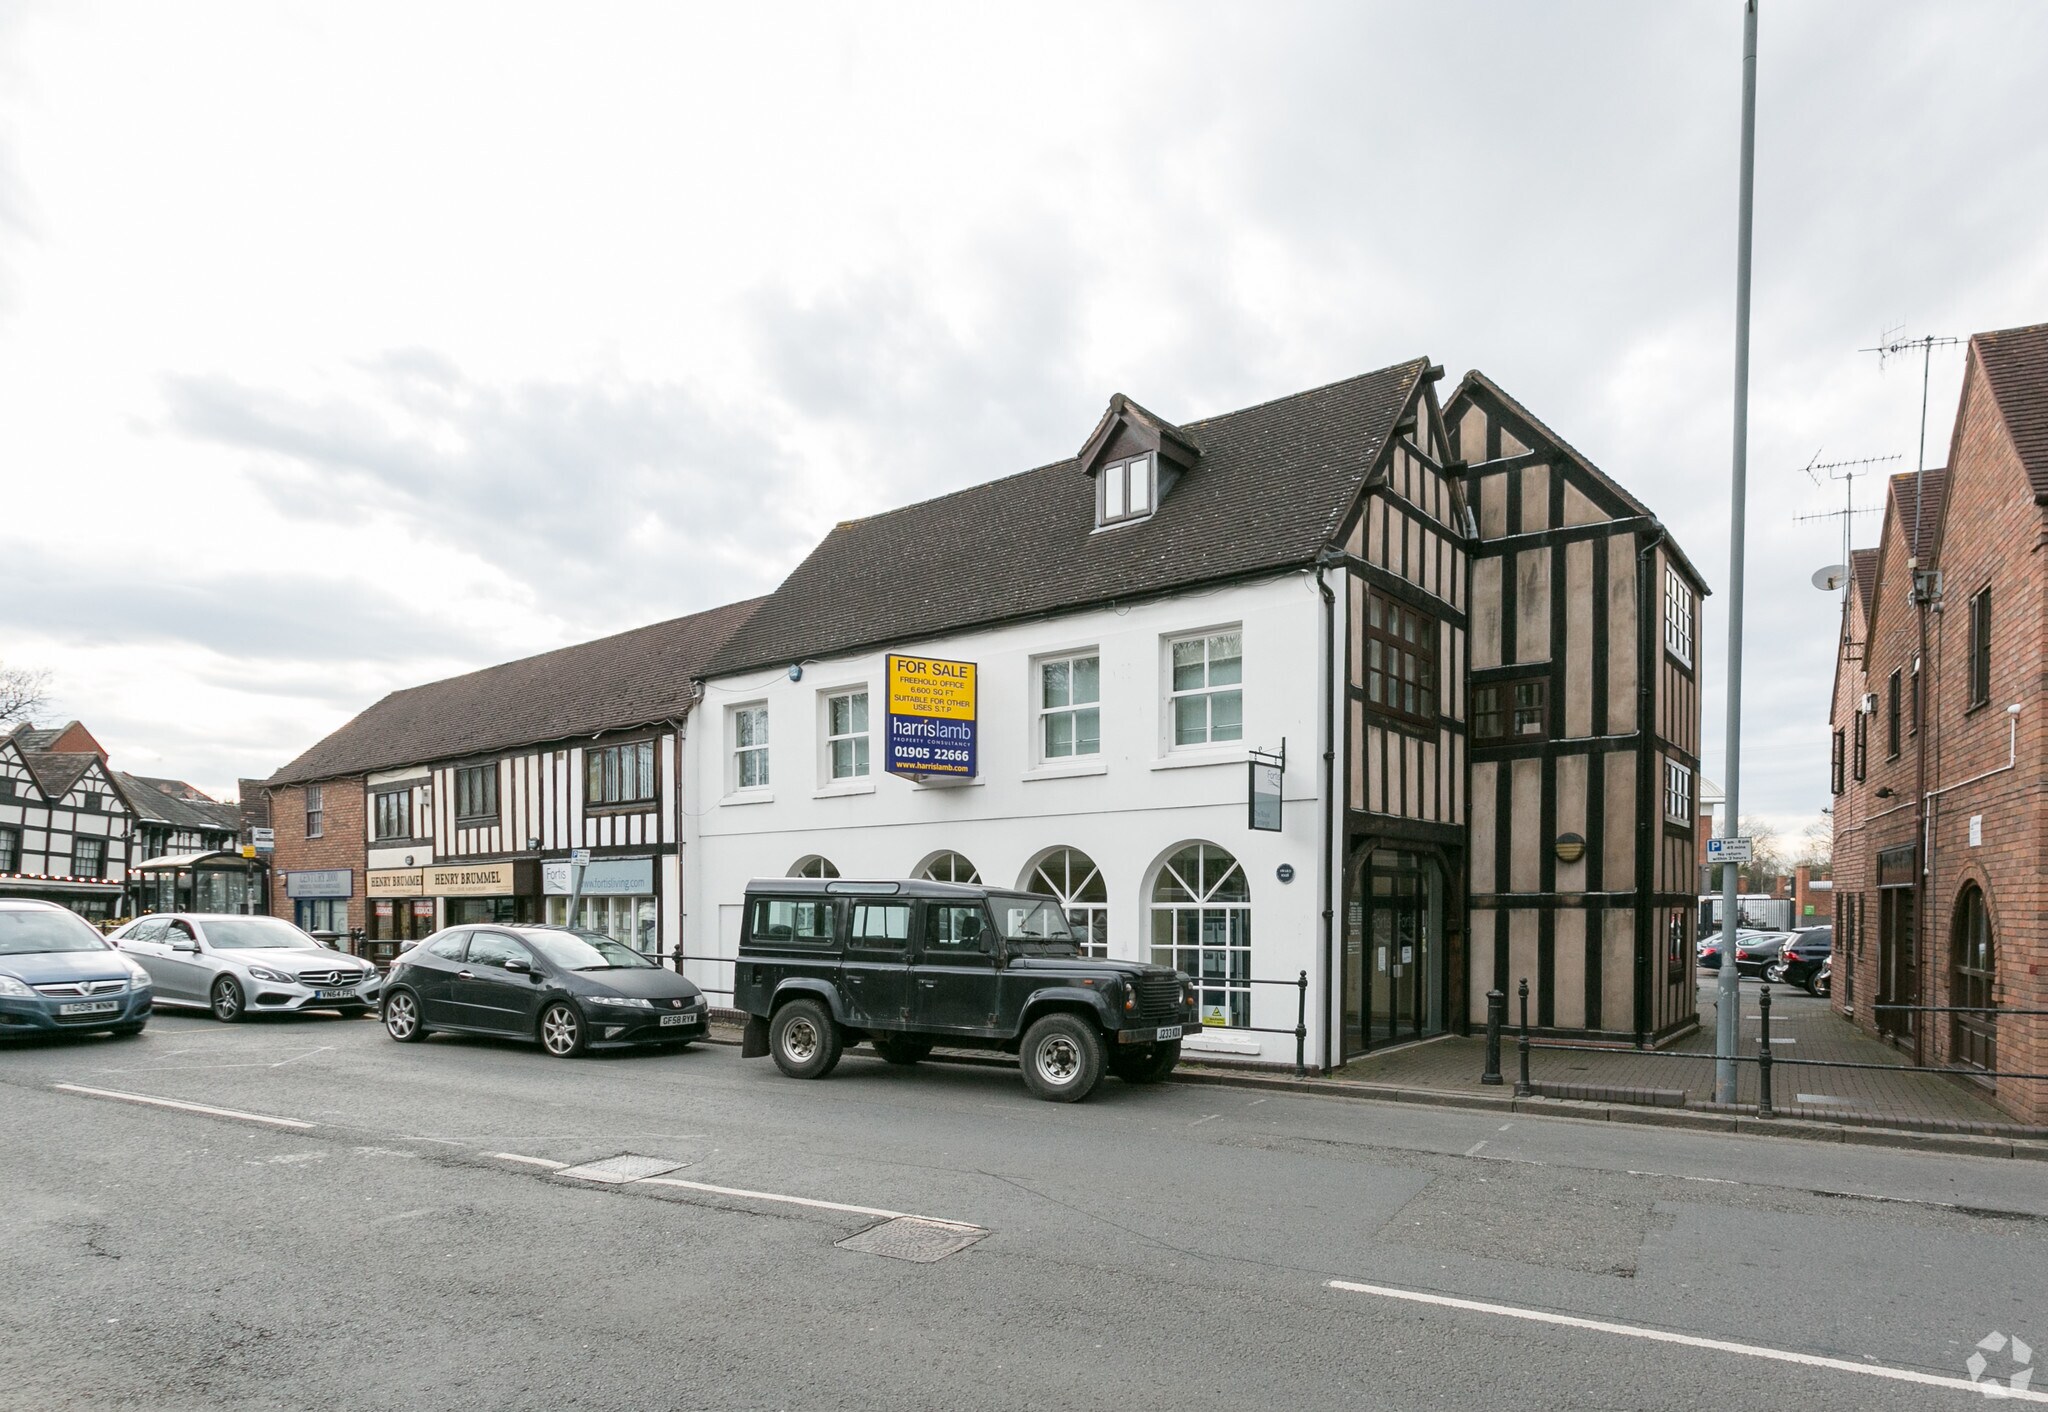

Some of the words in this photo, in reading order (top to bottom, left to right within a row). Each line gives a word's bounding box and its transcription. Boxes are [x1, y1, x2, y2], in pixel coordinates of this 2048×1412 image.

[897, 660, 927, 674] FOR
[932, 663, 968, 679] SALE
[899, 676, 937, 686] FREEHOLD
[940, 680, 964, 689] OFFICE
[894, 694, 928, 704] SUITABLE
[930, 697, 945, 705] FOR
[946, 699, 970, 708] OTHER
[913, 703, 932, 712] USES
[893, 716, 971, 740] harrislamb
[927, 739, 971, 747] CONSULTANCY
[894, 745, 930, 759] 01905
[934, 748, 969, 762] 22666
[896, 761, 968, 772] www.harrislamb.com
[1711, 841, 1720, 851] P
[434, 873, 460, 885] HENRY
[460, 871, 501, 885] BRUMMEL
[546, 867, 567, 880] Fortis
[371, 876, 391, 887] HENRY
[663, 1016, 682, 1025] GF58
[1159, 1028, 1172, 1040] J233
